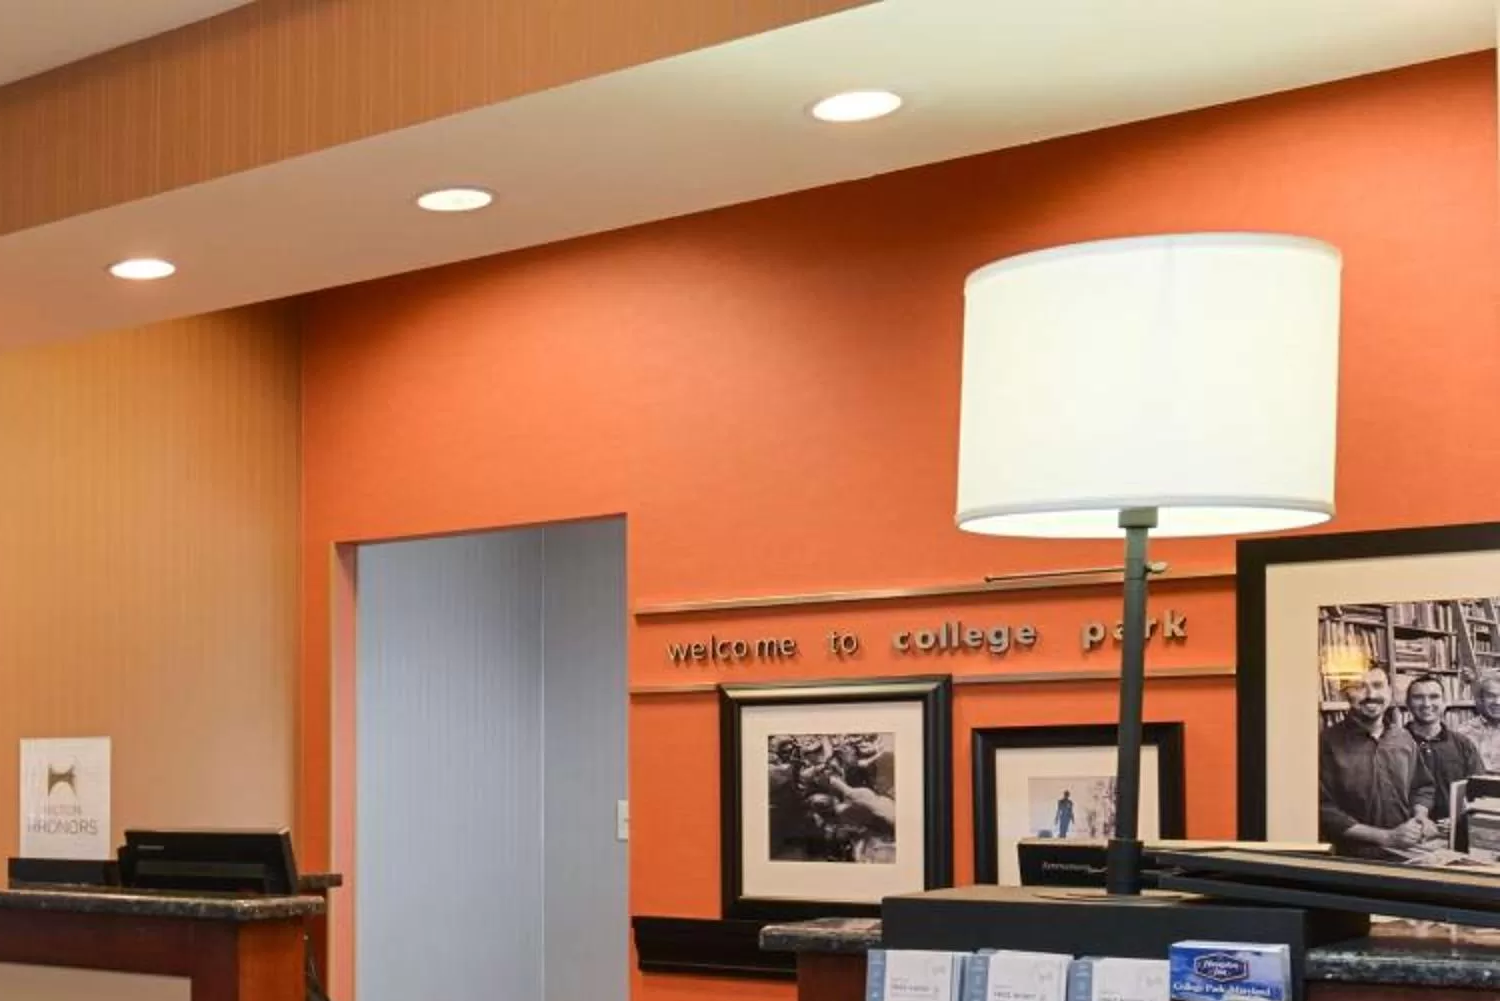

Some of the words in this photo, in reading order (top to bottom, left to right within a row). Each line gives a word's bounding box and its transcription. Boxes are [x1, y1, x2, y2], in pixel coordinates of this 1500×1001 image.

[667, 634, 798, 664] welcome
[829, 631, 859, 657] to
[892, 620, 1038, 655] college
